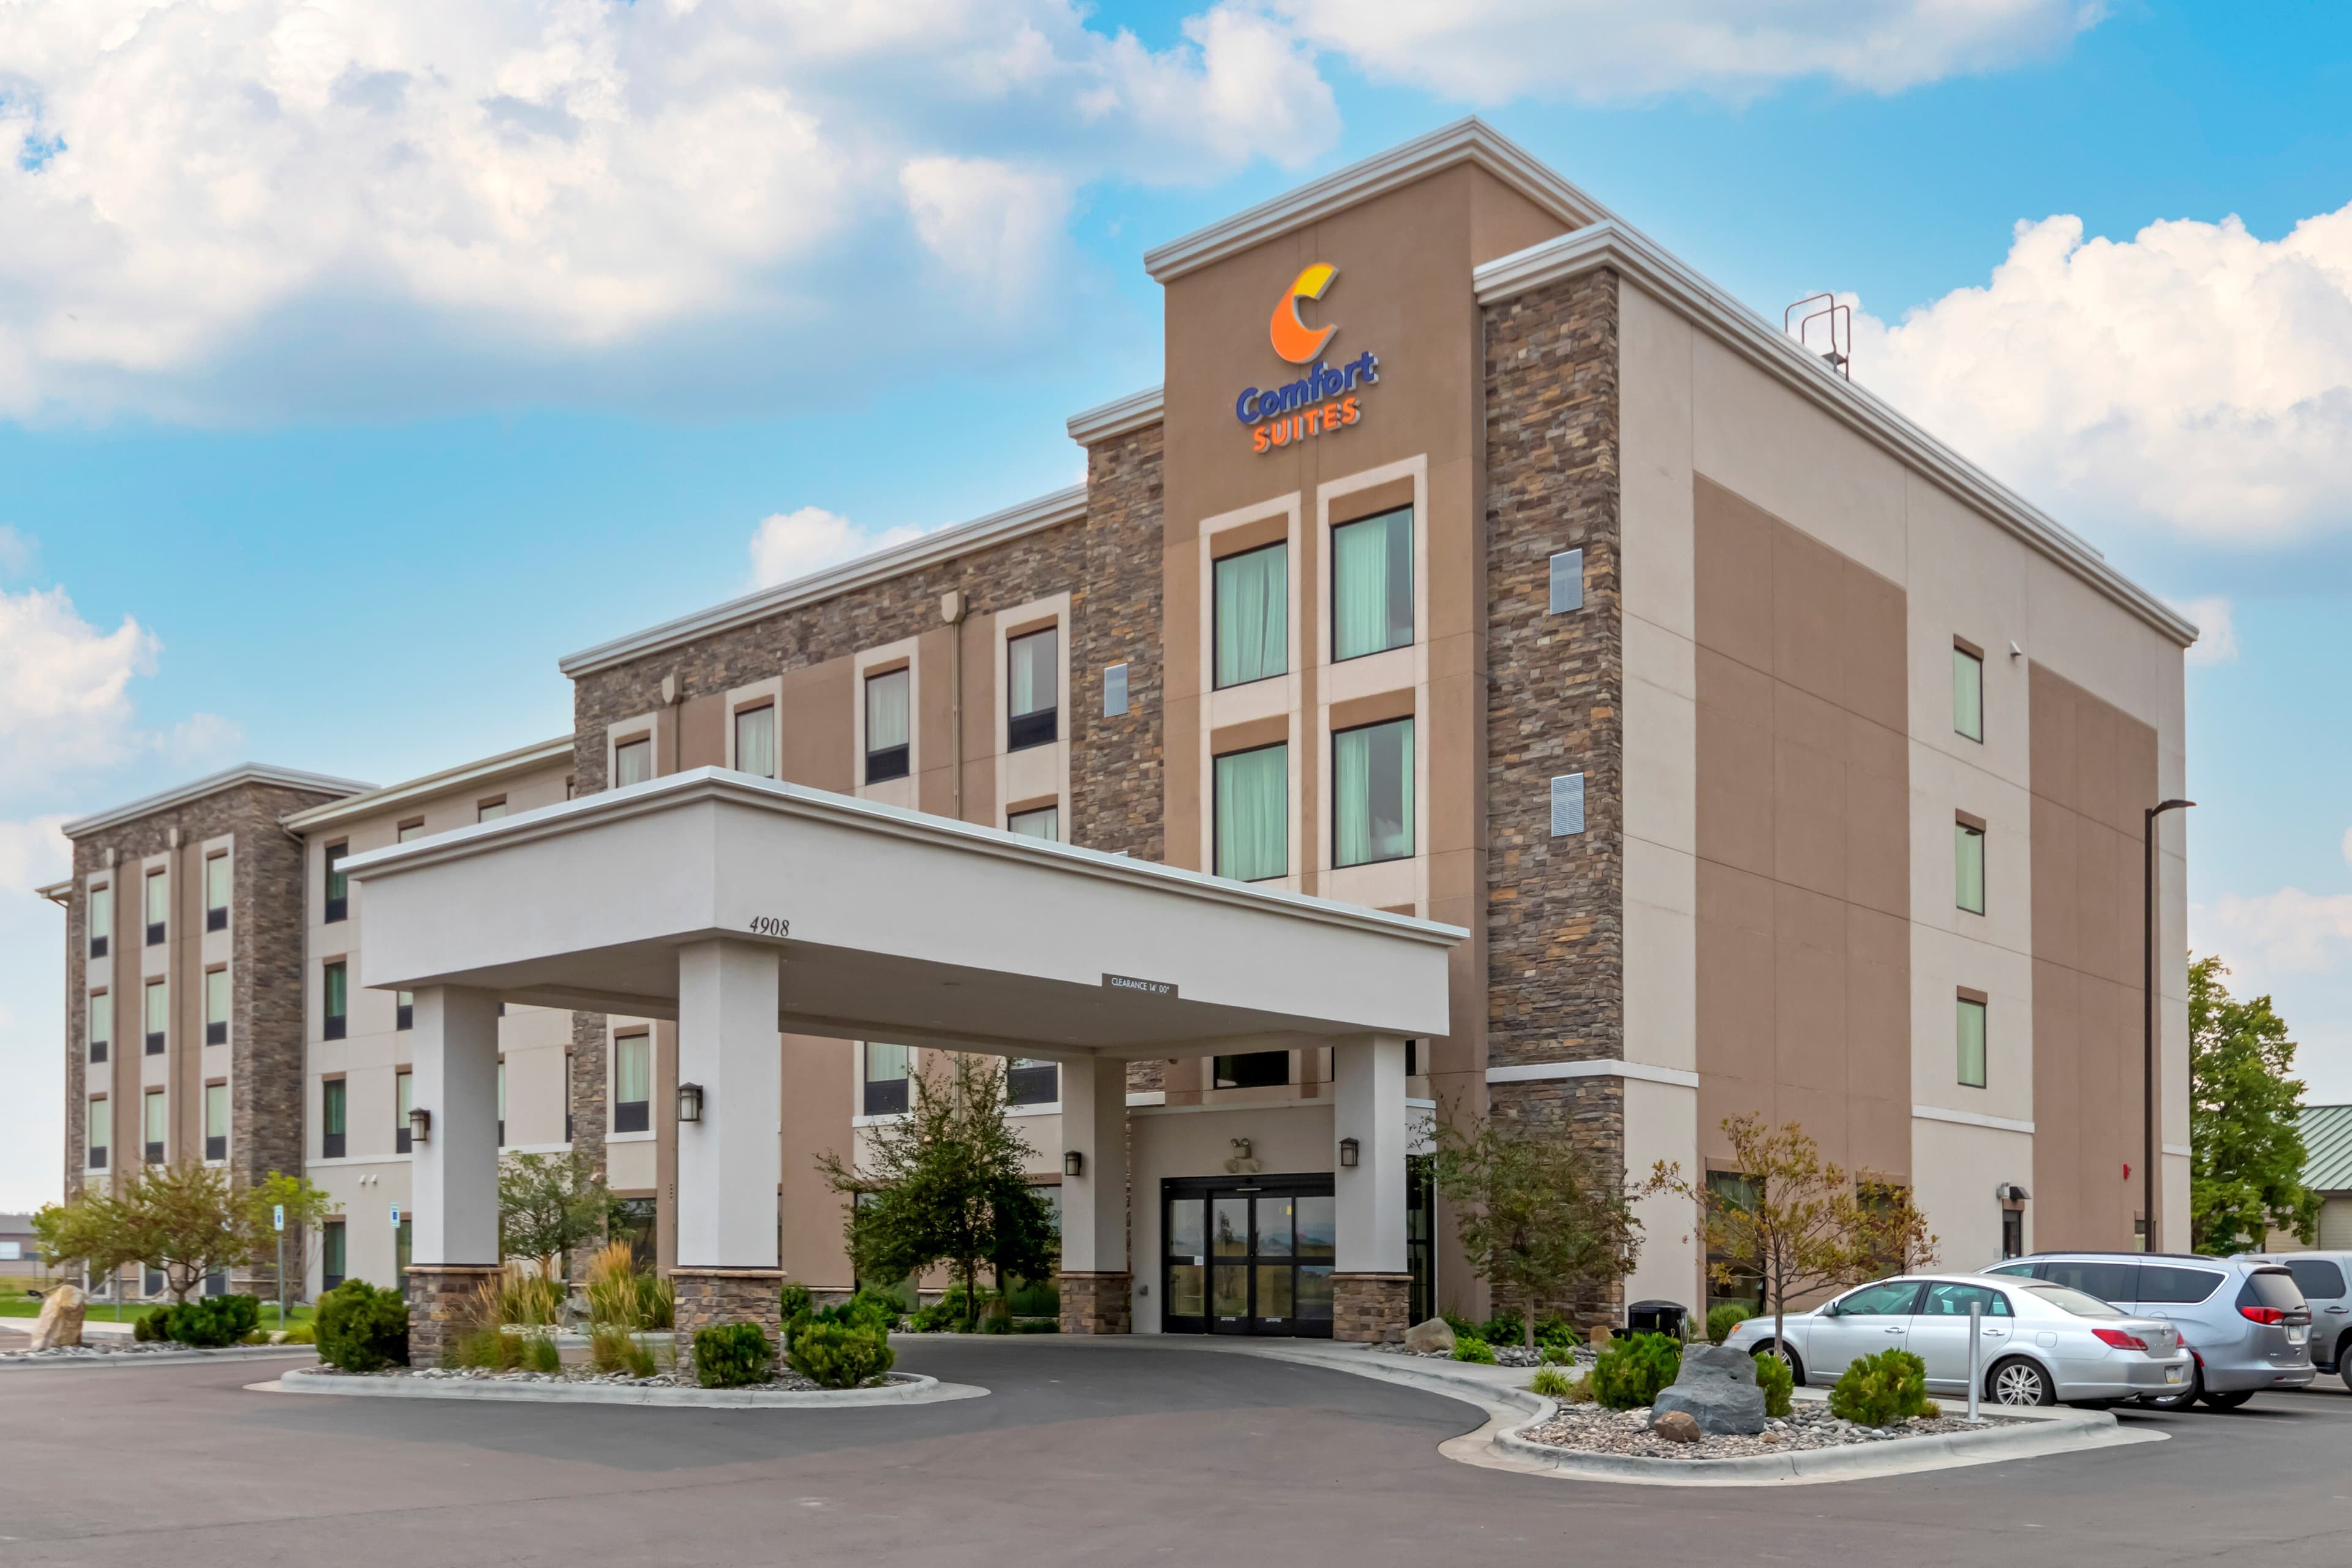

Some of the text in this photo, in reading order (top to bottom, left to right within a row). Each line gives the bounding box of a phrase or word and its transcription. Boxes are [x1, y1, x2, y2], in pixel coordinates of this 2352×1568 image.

[1236, 351, 1378, 424] Comfort
[1253, 397, 1361, 453] SUITES
[750, 916, 790, 937] 4908
[1111, 977, 1147, 990] CLEARANCE
